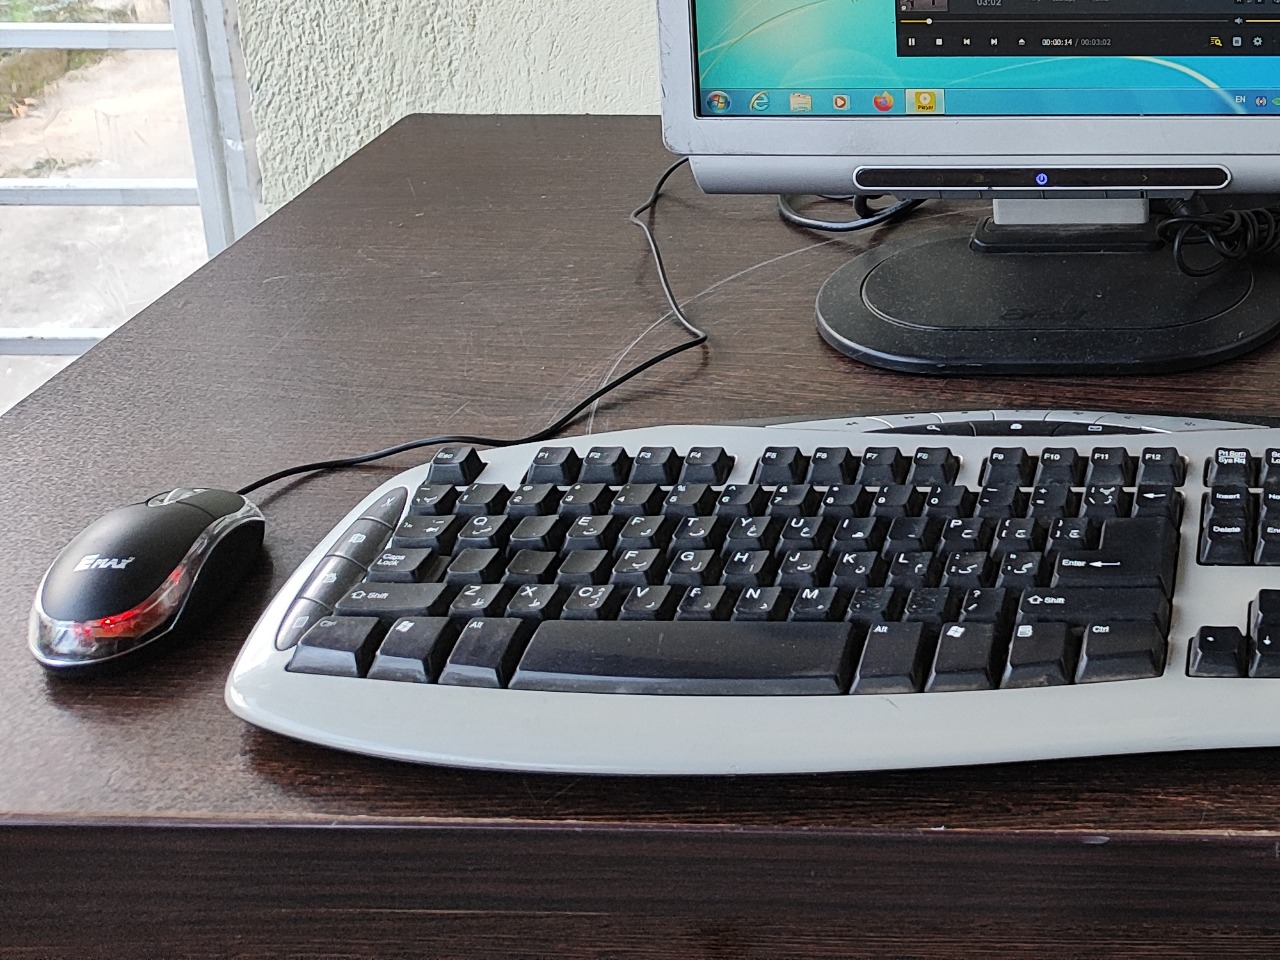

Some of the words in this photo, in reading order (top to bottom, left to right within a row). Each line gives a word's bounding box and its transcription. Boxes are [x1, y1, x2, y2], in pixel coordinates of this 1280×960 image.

[1041, 38, 1073, 46] 00:00:14
[1080, 38, 1112, 46] 00:03:02
[1235, 95, 1246, 103] EN
[473, 517, 488, 526] Q
[578, 516, 593, 526] E
[687, 517, 700, 527] T
[740, 517, 753, 527] Y
[791, 518, 804, 527] U
[950, 520, 963, 528] P
[382, 553, 406, 561] Caps
[624, 551, 639, 560] F
[680, 551, 695, 561] G
[733, 552, 750, 562] H
[789, 552, 800, 562] J
[842, 554, 857, 563] K
[898, 554, 909, 563] L
[1061, 559, 1087, 567] Enter
[464, 586, 481, 595] Z
[520, 586, 538, 597] X
[636, 587, 649, 597] V
[745, 588, 761, 598] N
[802, 589, 818, 599] M
[1044, 596, 1065, 604] Shift
[873, 625, 888, 633] Alt
[1092, 625, 1110, 633] Ctrl
